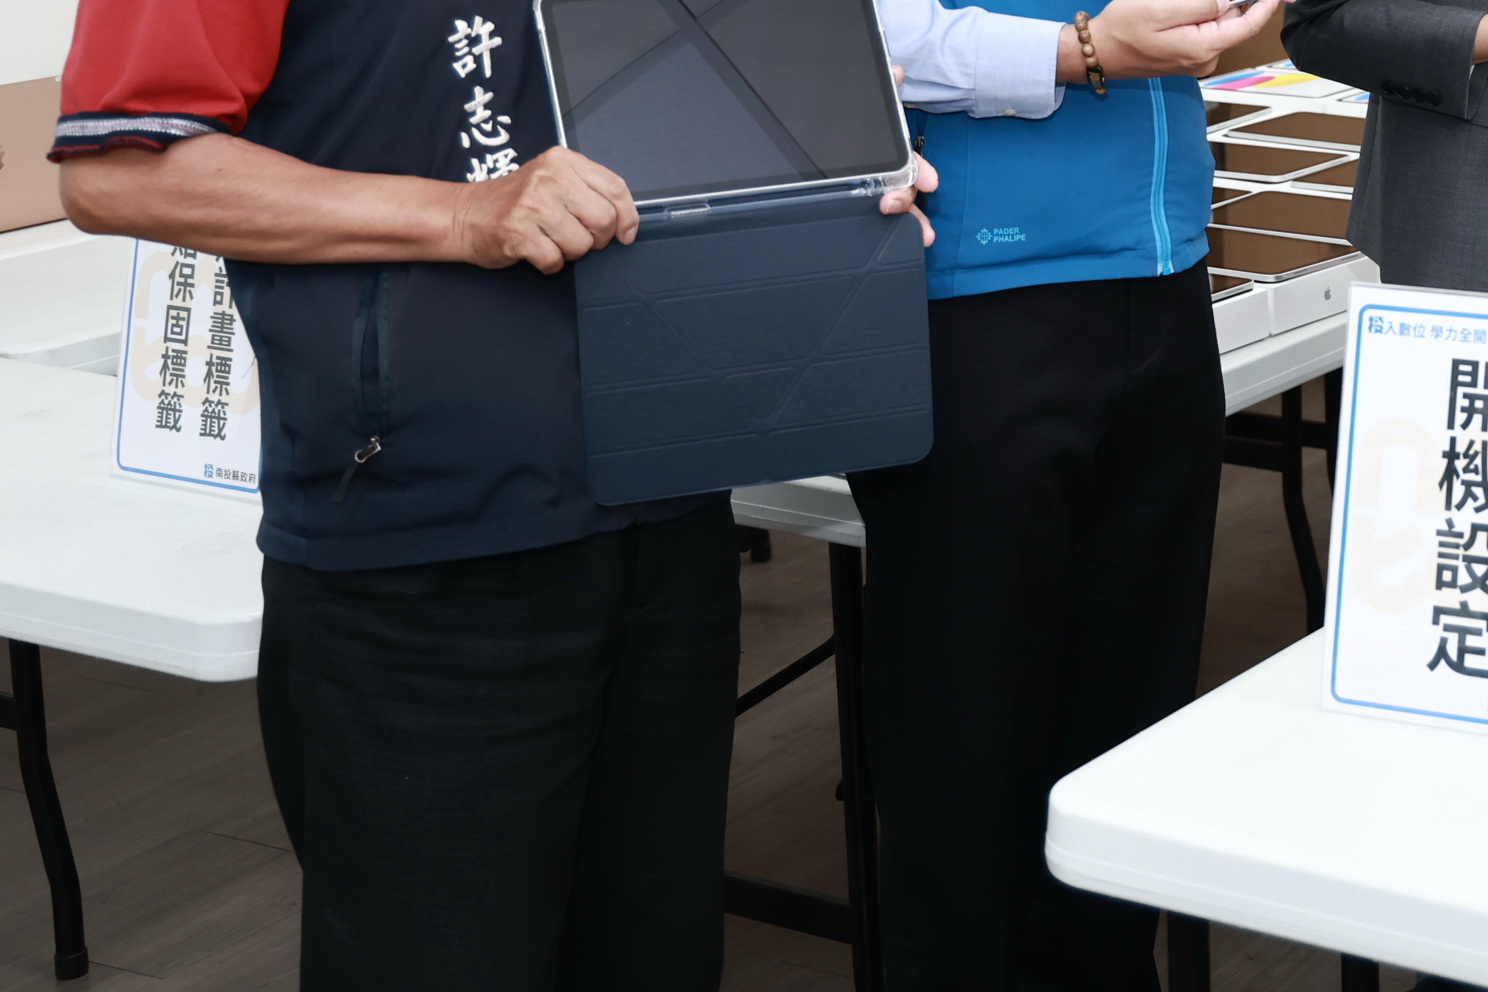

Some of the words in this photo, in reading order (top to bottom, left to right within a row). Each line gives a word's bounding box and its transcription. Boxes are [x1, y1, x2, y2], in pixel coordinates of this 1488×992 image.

[993, 227, 1020, 235] PADER
[993, 234, 1026, 243] PHALIPE
[1368, 315, 1426, 339] 投入數位
[1430, 324, 1488, 345] 學力全開
[198, 255, 237, 442] 計畫標籤
[215, 467, 257, 485] 南投縣政府
